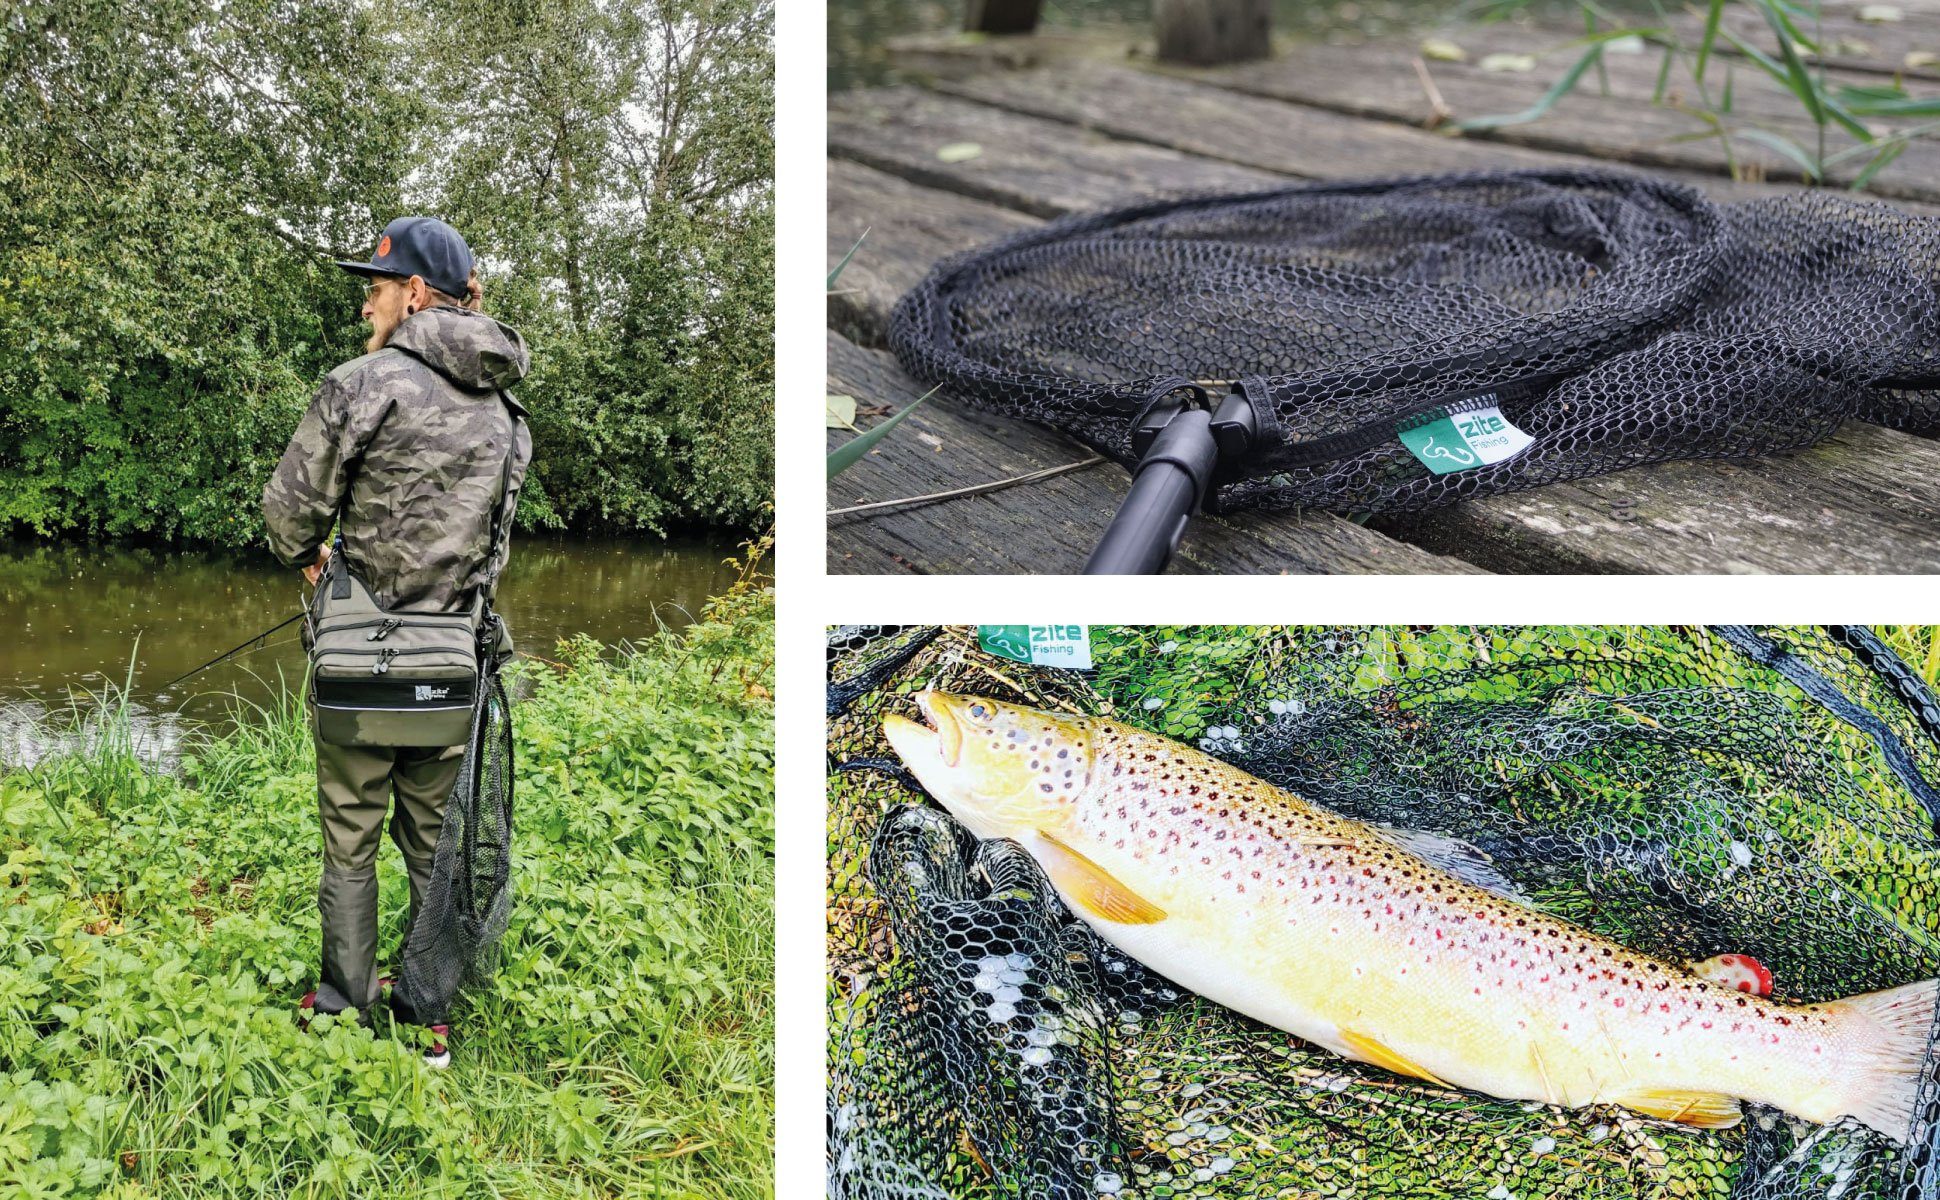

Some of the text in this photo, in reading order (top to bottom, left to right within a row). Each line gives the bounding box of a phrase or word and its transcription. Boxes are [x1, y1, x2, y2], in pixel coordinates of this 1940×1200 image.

[1459, 415, 1506, 438] zite
[1471, 435, 1509, 450] Fishing
[1031, 625, 1082, 642] zite
[1033, 645, 1074, 655] Fishing
